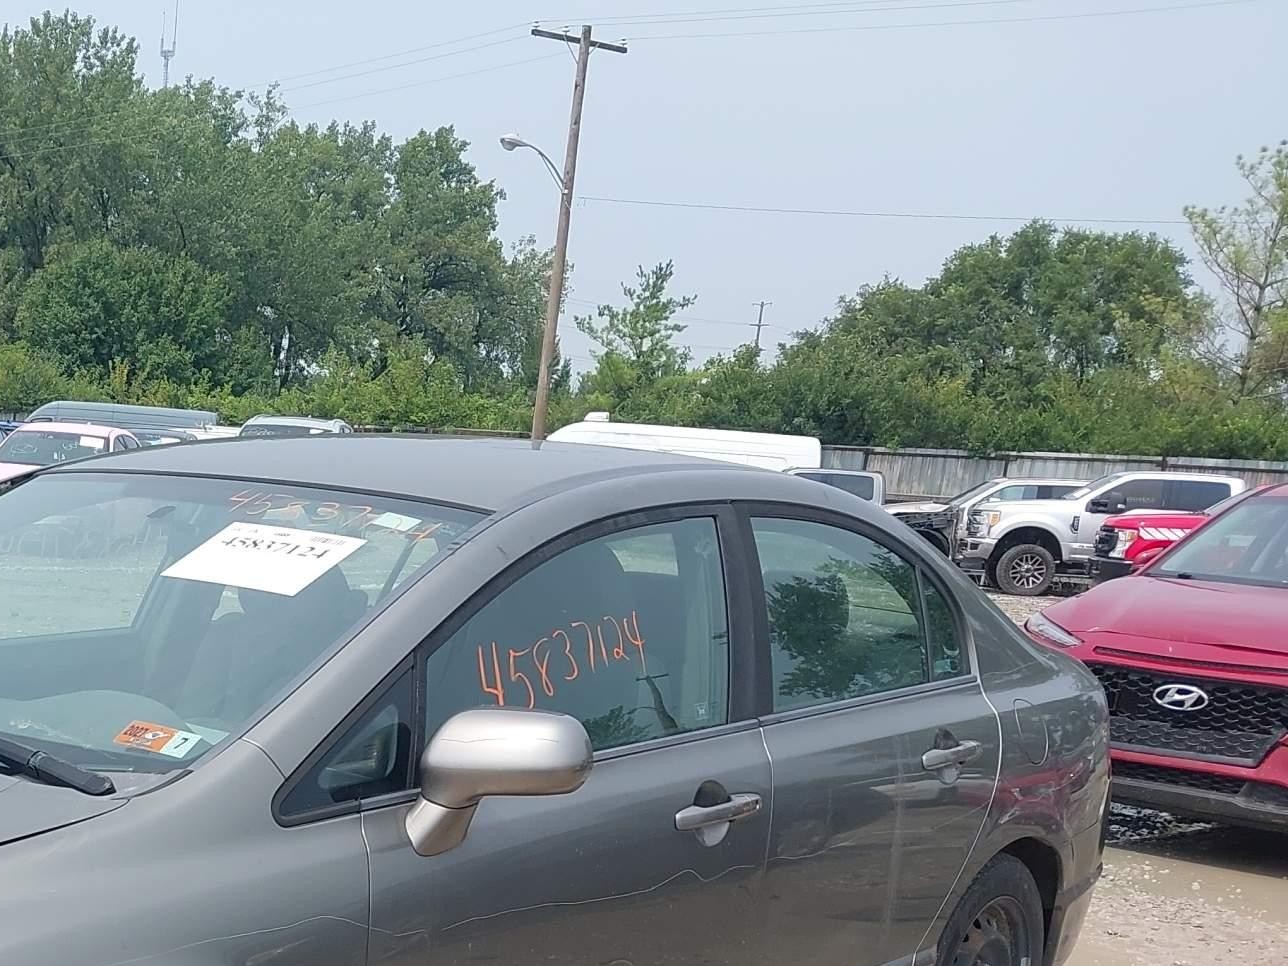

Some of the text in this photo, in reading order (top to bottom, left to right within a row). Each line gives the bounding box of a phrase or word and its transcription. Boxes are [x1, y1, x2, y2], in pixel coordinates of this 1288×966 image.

[221, 536, 331, 559] 45837124
[476, 610, 647, 709] 45837124
[173, 737, 189, 750] 7
